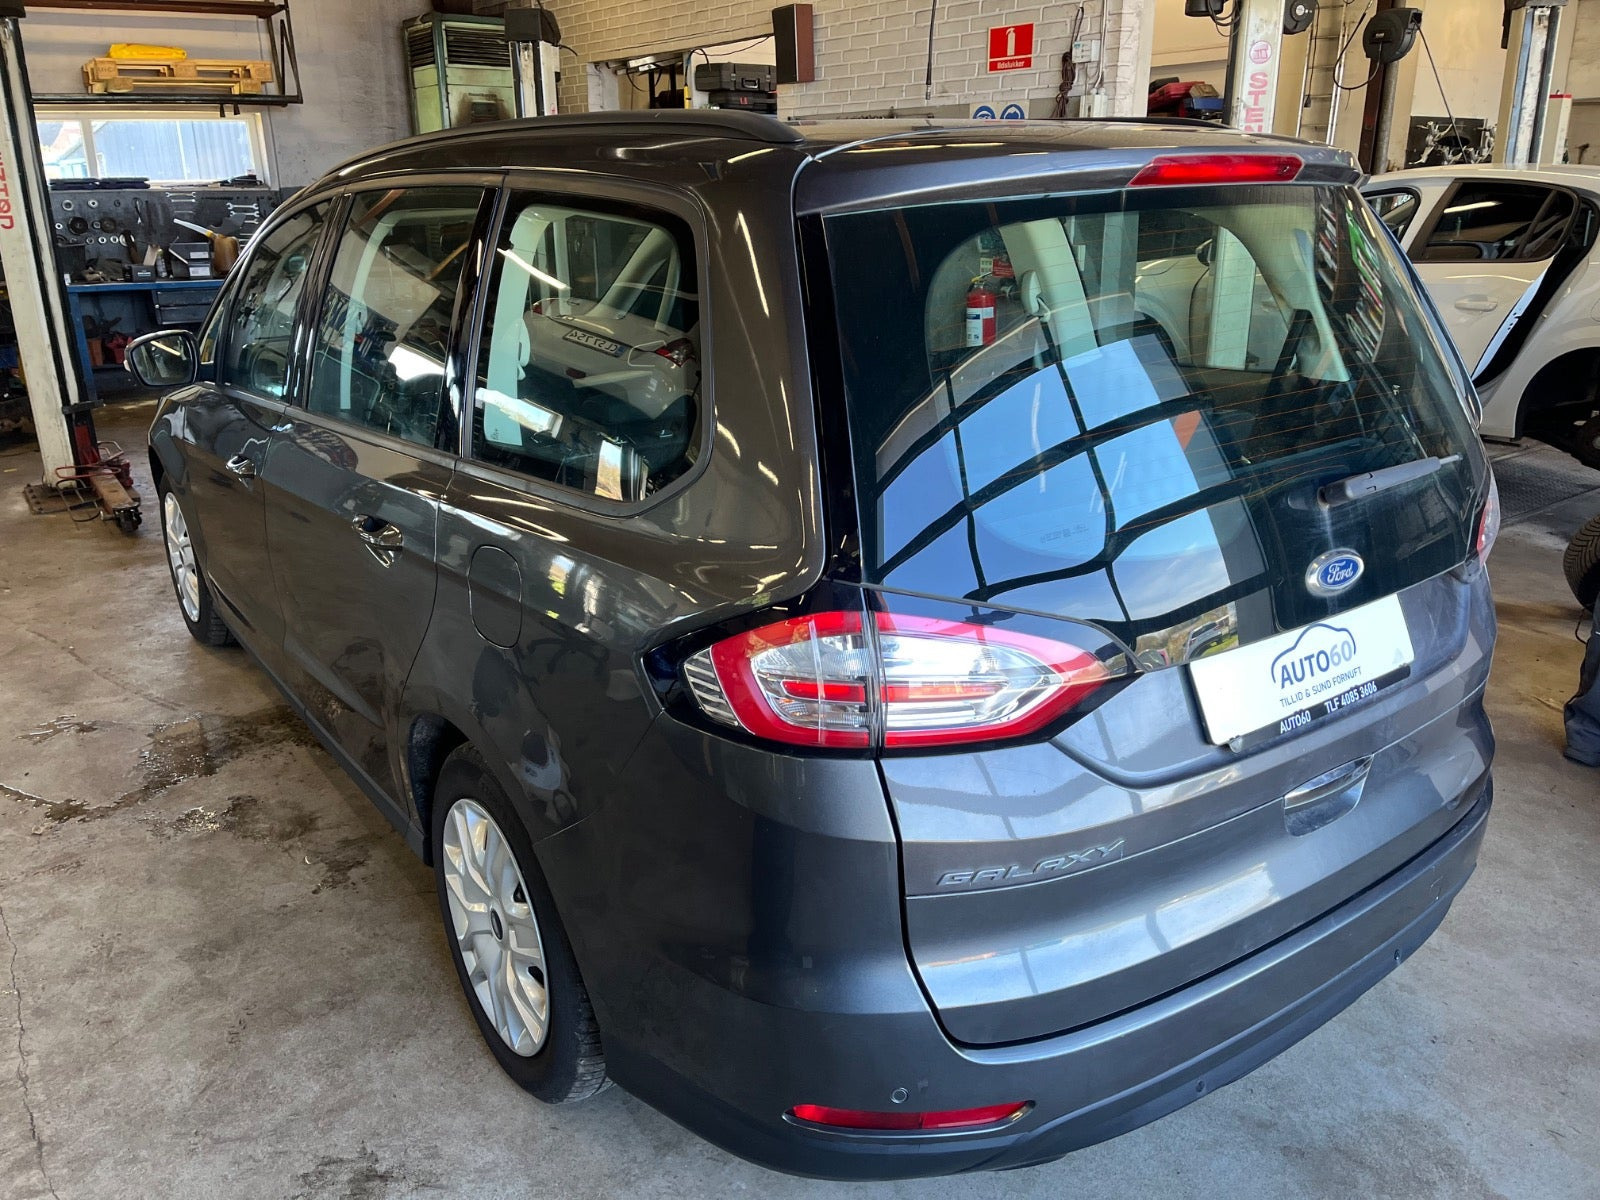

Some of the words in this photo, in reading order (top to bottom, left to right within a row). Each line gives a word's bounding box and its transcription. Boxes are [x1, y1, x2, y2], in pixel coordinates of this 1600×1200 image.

[997, 61, 1025, 69] Ildslukker
[1326, 561, 1354, 584] Ford
[1281, 640, 1352, 689] AUTO60
[1280, 691, 1304, 708] TILLID
[1311, 680, 1332, 695] SUND
[1332, 666, 1362, 686] FORNUFT
[1280, 710, 1312, 734] AUTO60
[1323, 697, 1340, 714] TLF
[1341, 688, 1360, 706] 4085
[1360, 681, 1378, 698] 3606
[936, 840, 1125, 885] GALAXY
